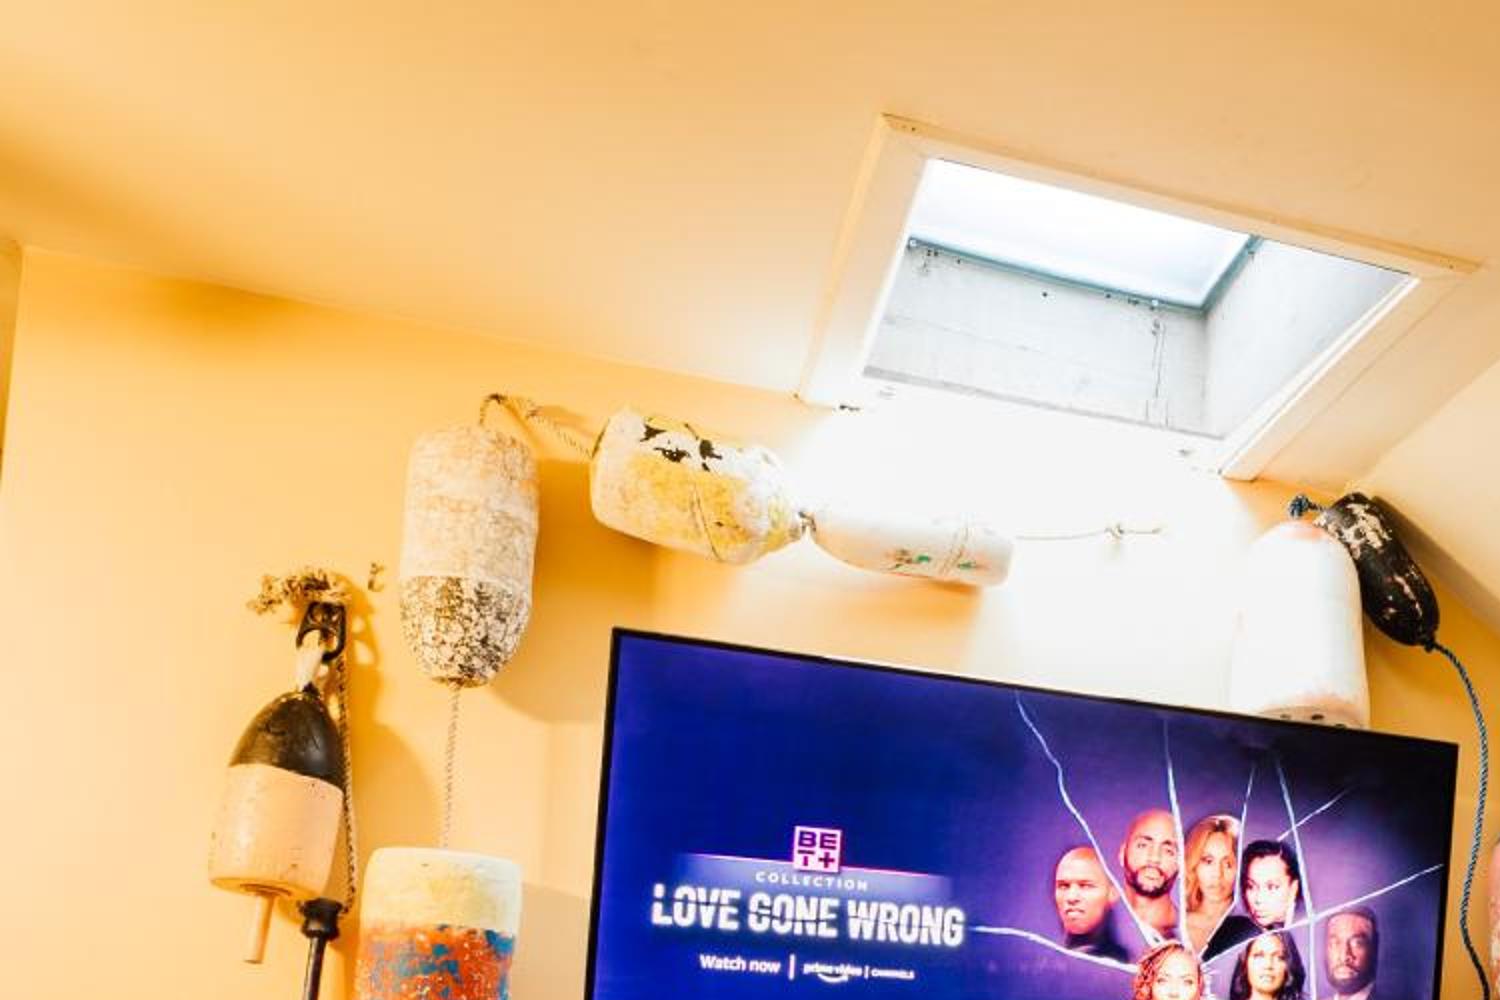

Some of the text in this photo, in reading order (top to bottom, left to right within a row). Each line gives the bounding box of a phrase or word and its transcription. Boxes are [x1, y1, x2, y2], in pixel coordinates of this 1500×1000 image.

[755, 870, 869, 892] COLLECTION
[651, 882, 966, 948] LOVE GONE WRONG
[700, 954, 746, 972] Watch
[749, 959, 782, 974] now
